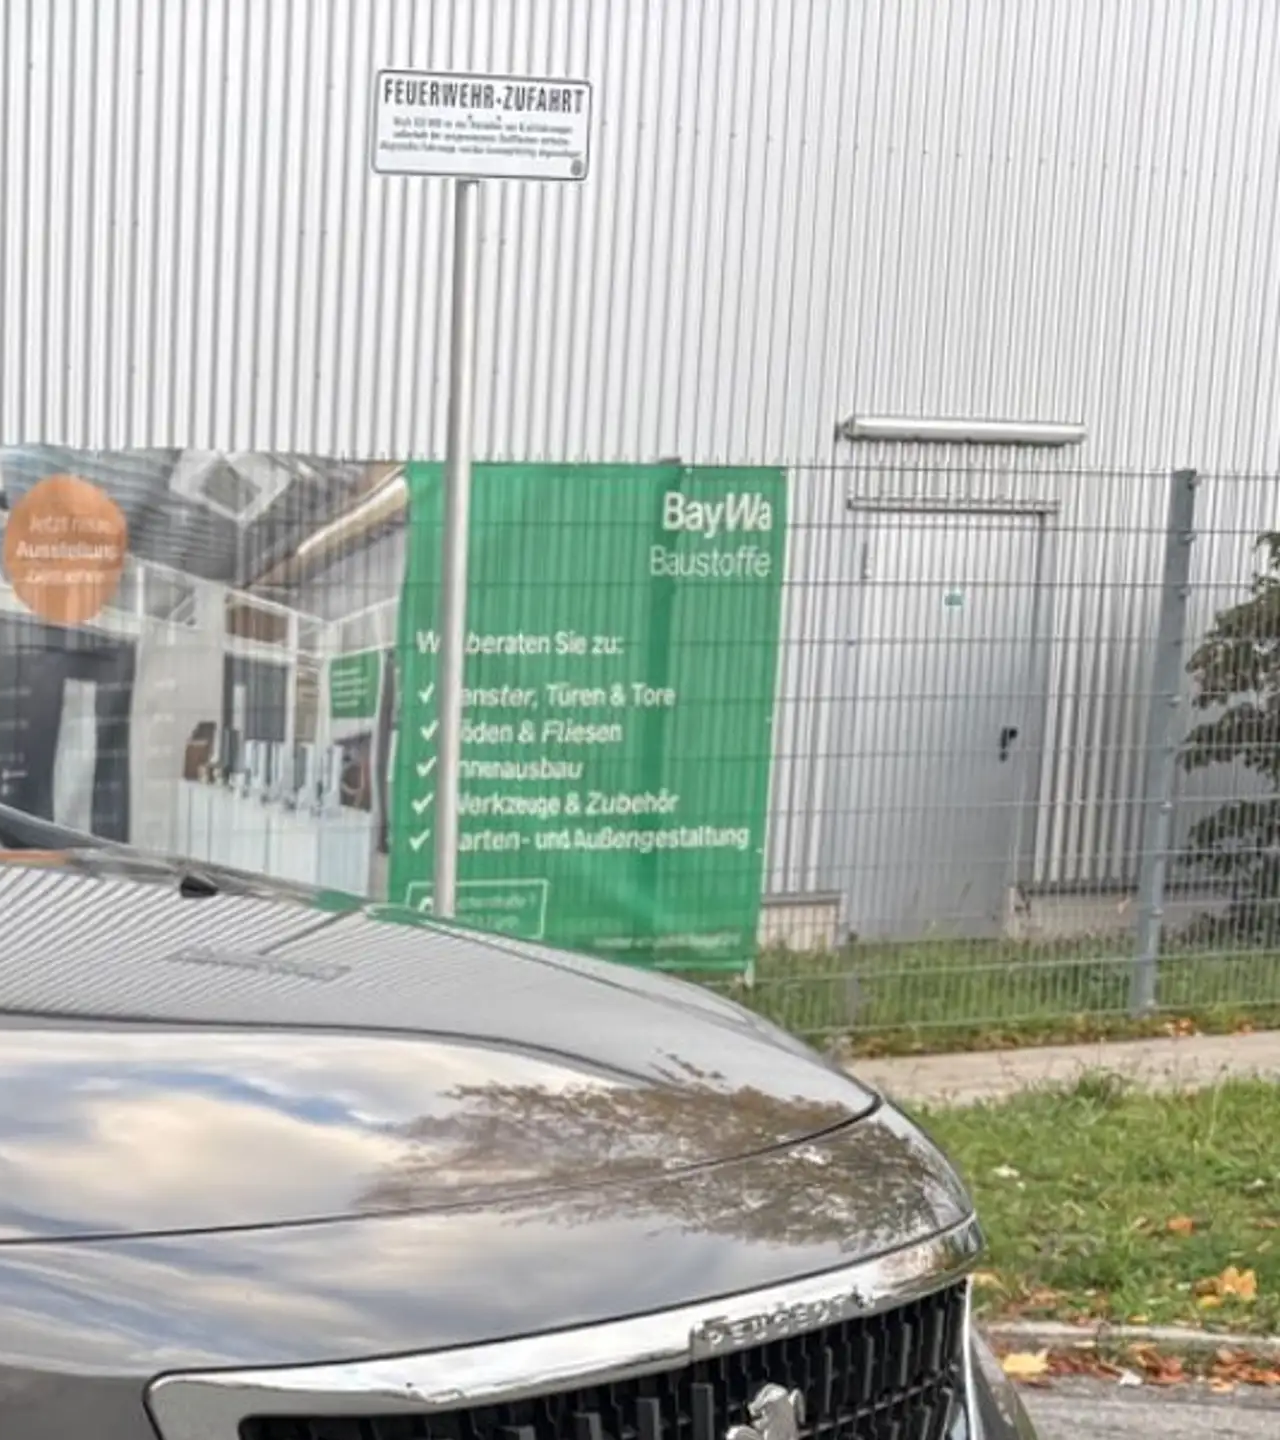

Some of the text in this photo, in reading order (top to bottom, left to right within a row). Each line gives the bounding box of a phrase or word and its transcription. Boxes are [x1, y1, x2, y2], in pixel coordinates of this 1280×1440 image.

[383, 78, 585, 114] FEUERWEHR-ZUFAHRT
[662, 490, 773, 539] BayWa
[650, 544, 772, 578] Baustoffe
[465, 631, 551, 656] beraten
[555, 630, 588, 656] Sie
[591, 636, 625, 655] zu:
[460, 682, 676, 709] enster, Türen & Tore
[458, 719, 623, 744] öden & Fliesen
[457, 756, 585, 781] nnenausbau
[564, 792, 581, 815] &
[584, 787, 680, 815] Zubehör
[458, 825, 750, 855] arten- und Außengestaltung
